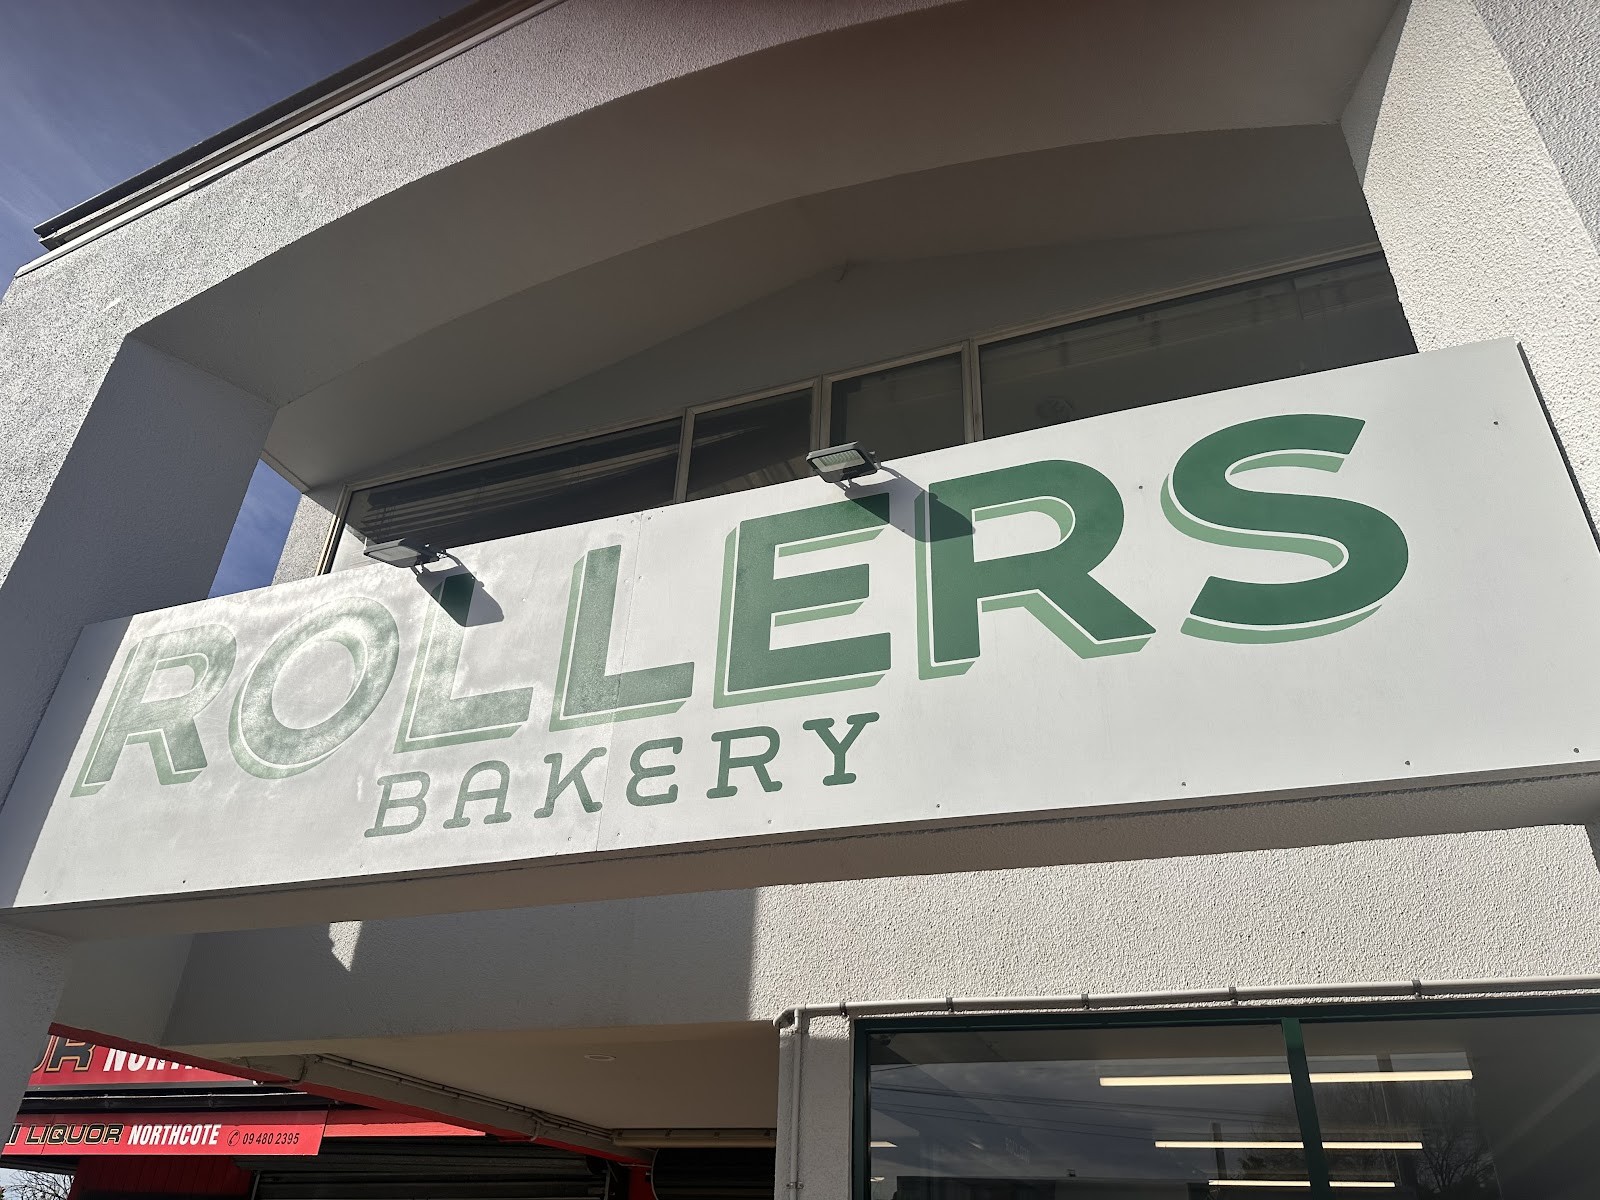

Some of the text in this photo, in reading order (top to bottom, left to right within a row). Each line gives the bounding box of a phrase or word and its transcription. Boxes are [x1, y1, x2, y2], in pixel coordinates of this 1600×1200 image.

[71, 412, 1409, 798] ROLLERS
[364, 711, 880, 837] BAKERY
[24, 1123, 125, 1145] LIQUOR
[126, 1123, 222, 1146] NORTHCOTE
[242, 1132, 255, 1145] 09
[255, 1132, 274, 1145] 480
[275, 1132, 300, 1145] 2395
